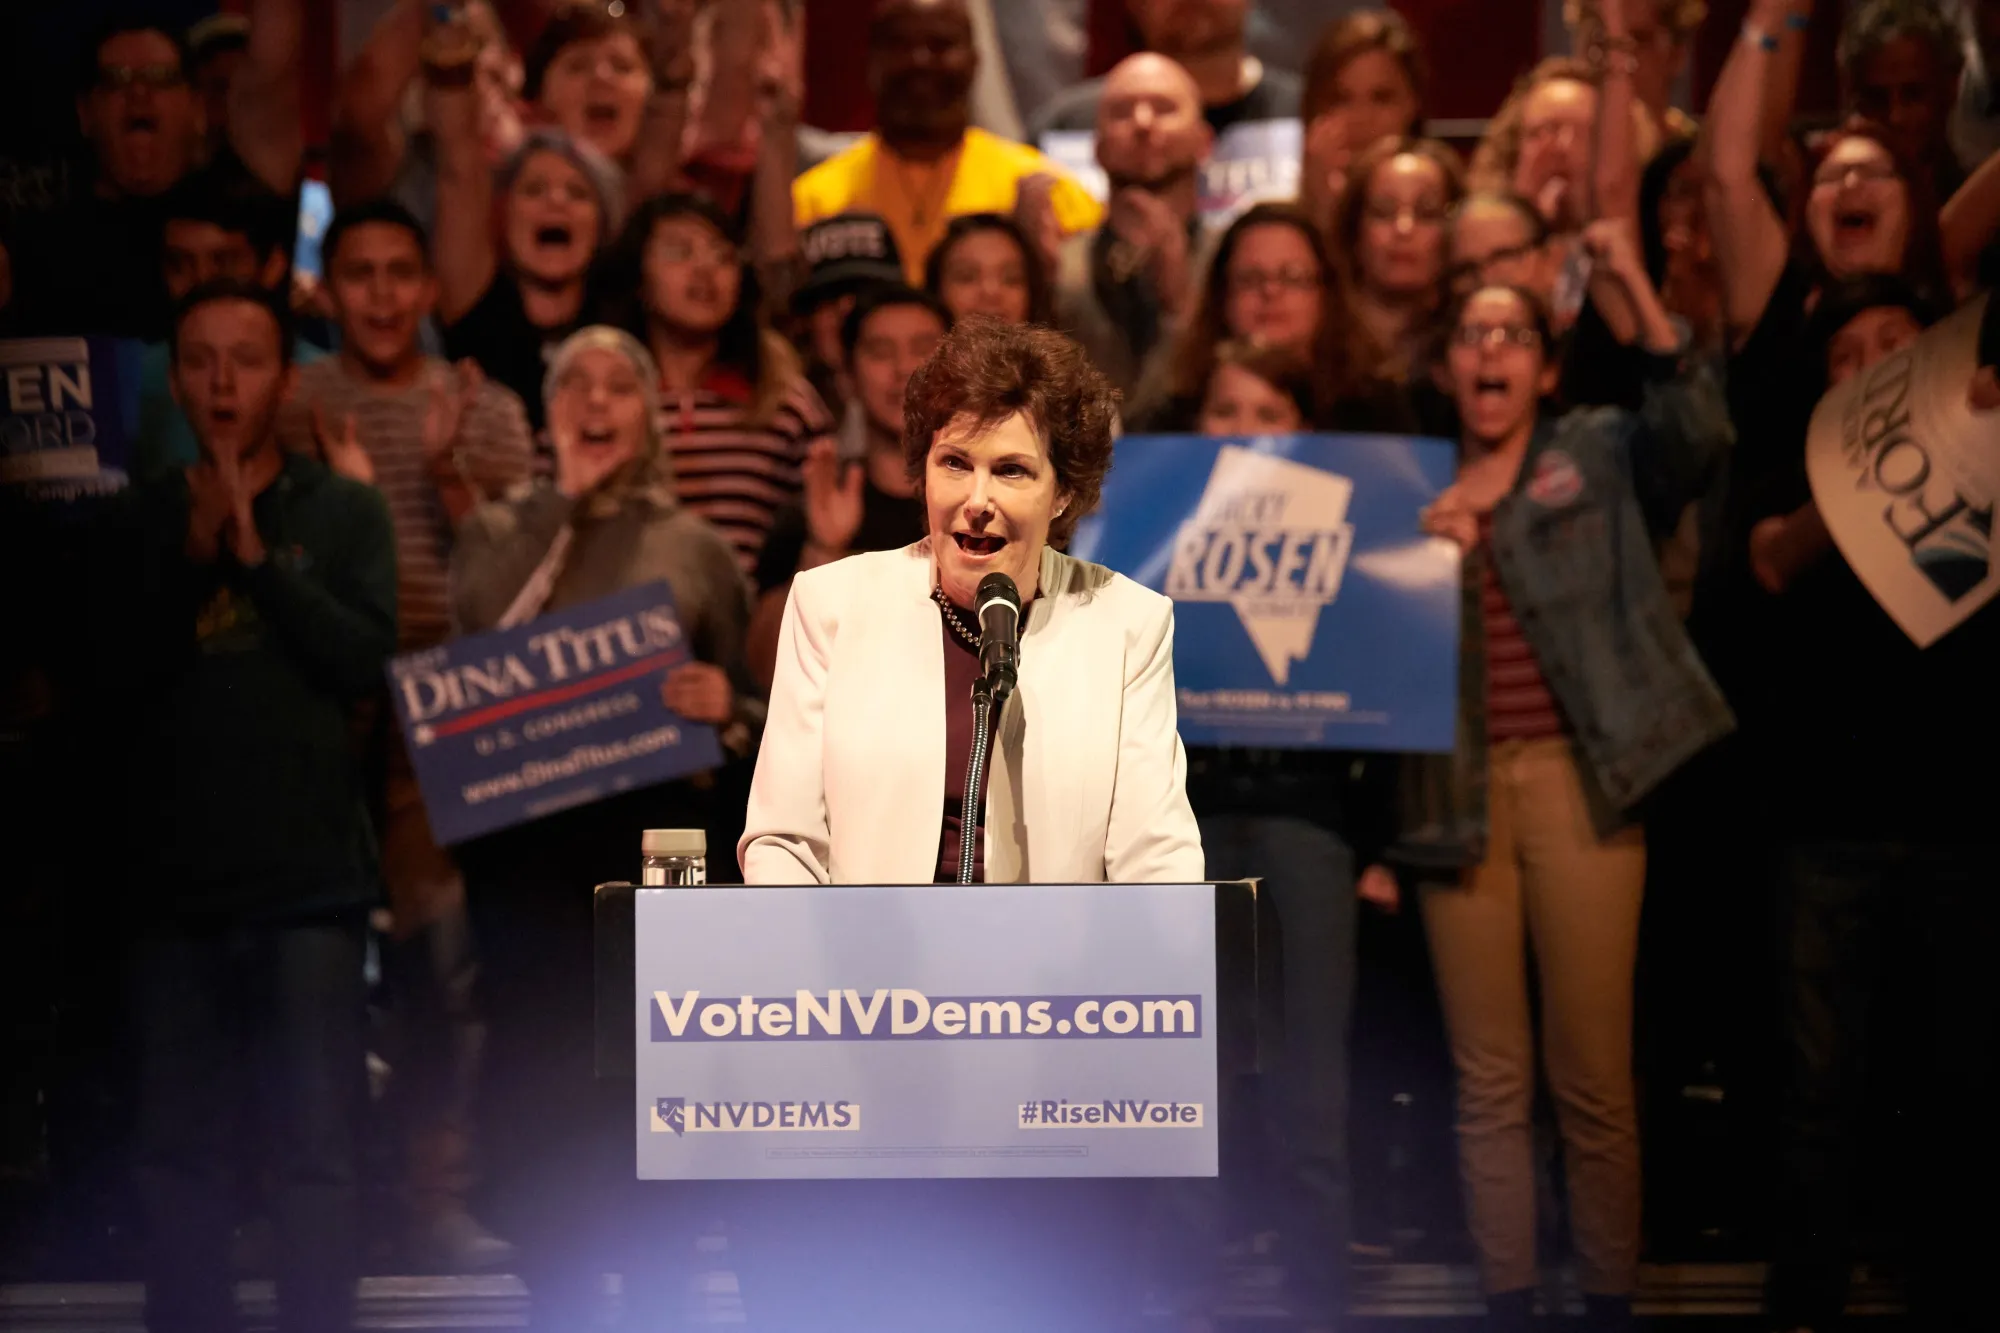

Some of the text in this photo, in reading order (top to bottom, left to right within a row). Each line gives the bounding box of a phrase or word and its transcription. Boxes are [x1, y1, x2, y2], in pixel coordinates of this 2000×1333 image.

[804, 221, 886, 263] VOTE
[0, 362, 93, 414] EN
[1863, 352, 1968, 553] FORD
[1165, 524, 1354, 602] ROSEN
[401, 605, 684, 722] DINA TITUS
[461, 724, 681, 804] www.DinaTitus.com
[654, 988, 1195, 1037] VoteNVDems.com
[694, 1099, 1197, 1128] NVDEMS #RiseNVote
